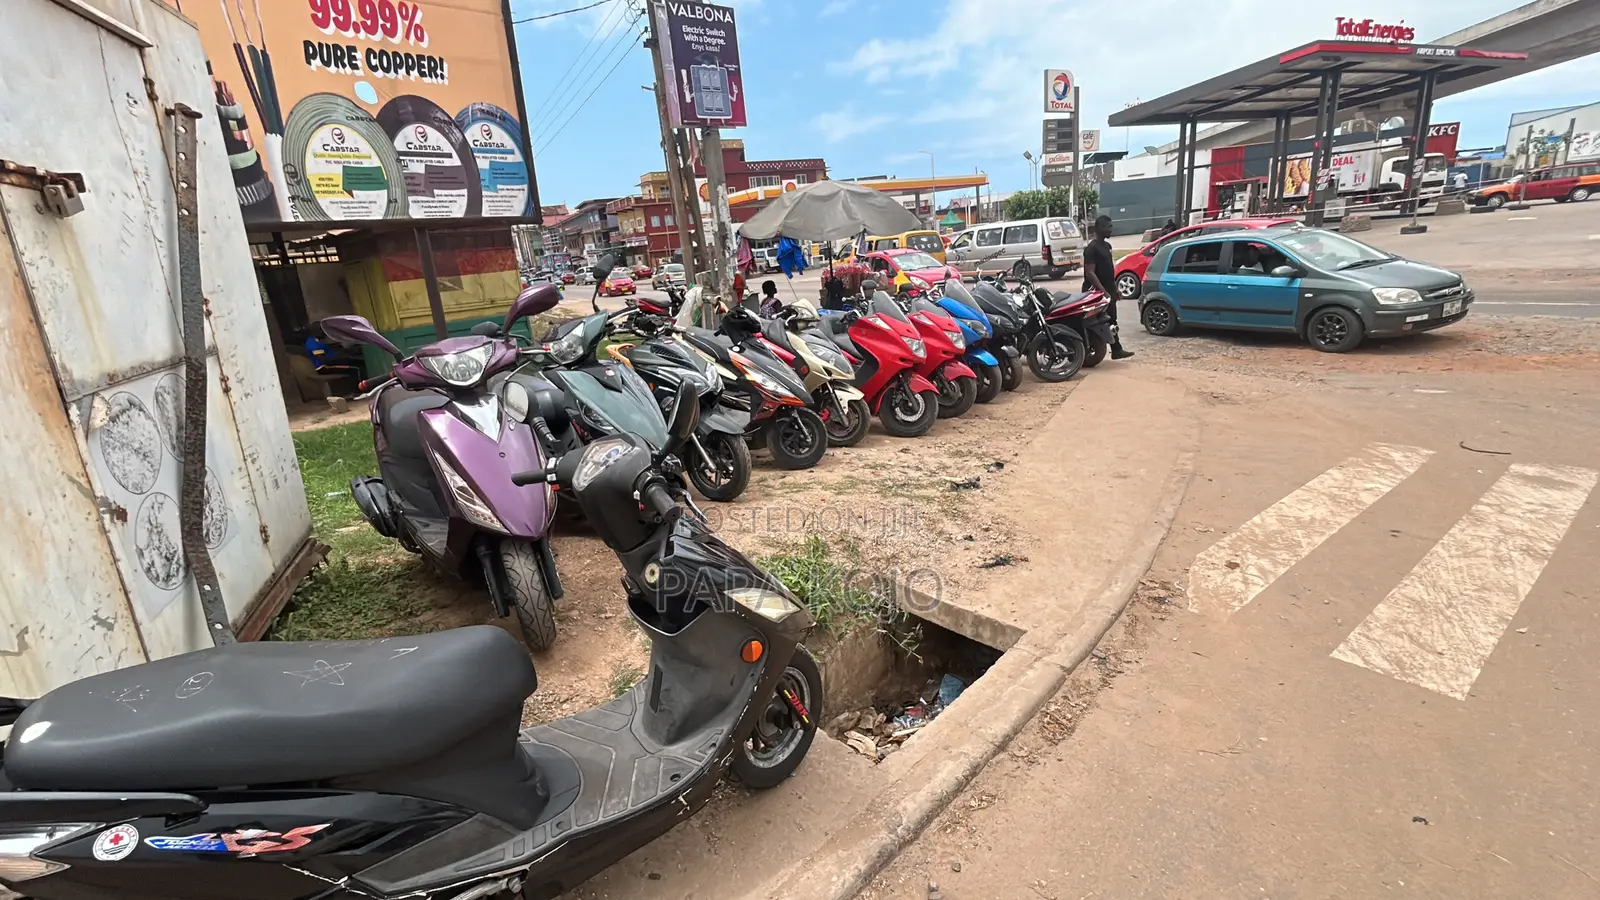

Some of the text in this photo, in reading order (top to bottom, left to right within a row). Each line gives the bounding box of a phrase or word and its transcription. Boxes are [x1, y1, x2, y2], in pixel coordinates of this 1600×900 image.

[668, 2, 734, 23] VALBONA
[308, 0, 427, 46] 99.99%
[1335, 16, 1415, 43] TotalEnergies
[681, 24, 726, 38] Electric Switch
[683, 33, 699, 42] With
[703, 36, 726, 46] Degree.
[303, 40, 447, 82] PURE COPPER!
[1050, 101, 1073, 110] TOTAL
[1427, 124, 1458, 137] KFC
[322, 143, 361, 153] CABSTAR
[406, 141, 444, 152] CABSTAR
[472, 139, 507, 149] CABSTAR
[1332, 155, 1355, 167] DEAL
